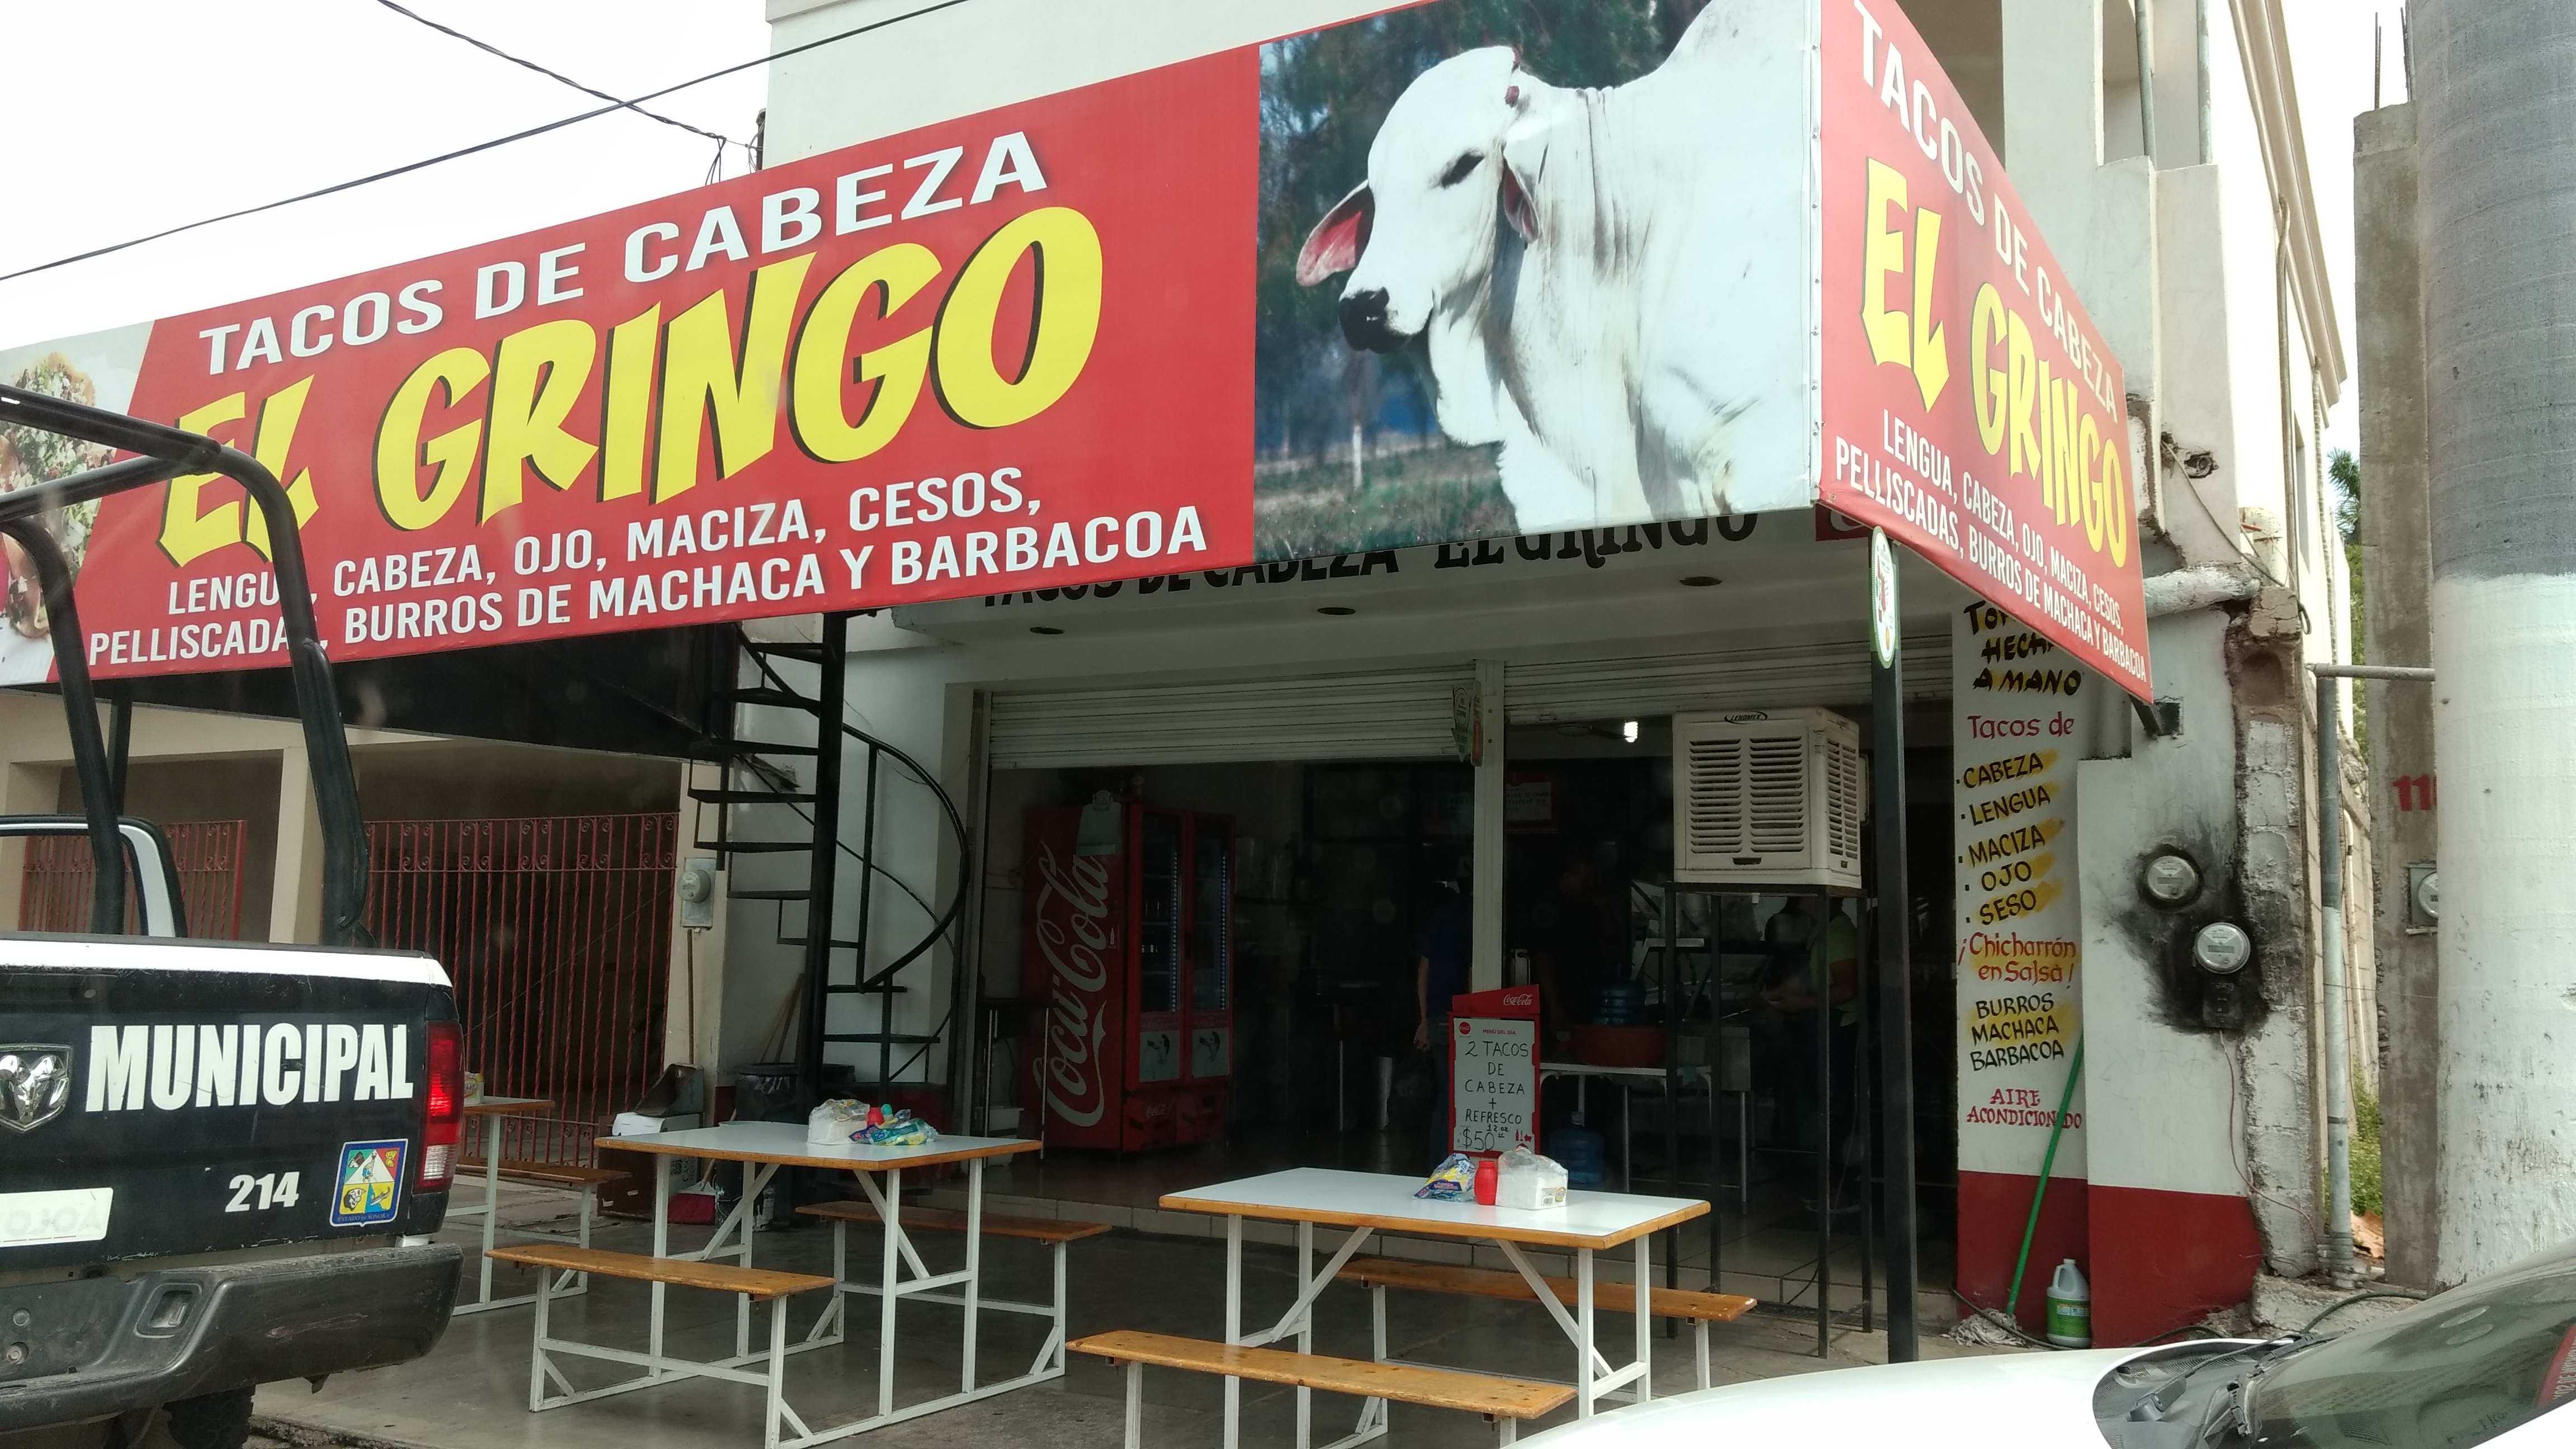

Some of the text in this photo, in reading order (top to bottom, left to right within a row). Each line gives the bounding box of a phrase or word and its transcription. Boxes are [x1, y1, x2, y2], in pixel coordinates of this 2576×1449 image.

[1853, 0, 2119, 423] TACOS DE CABEZA
[199, 131, 1048, 375] TACOS DE CABEZA
[1860, 156, 2127, 568] EL GRINGO
[157, 206, 1103, 567] EL GRINGO
[1883, 409, 2124, 636] LENGUA, CABEZA, OJO, MACIZA, CESOS,
[168, 467, 1040, 615] LENGU, CABEZA, OJO, MACIZA, CESOS,
[1835, 435, 2147, 683] PELLISCADAS, BURROS DE MACHACA Y BARBACOA
[89, 616, 328, 666] PELLISCADA,
[345, 593, 503, 644] BURROS
[518, 584, 571, 627] DE
[589, 553, 825, 619] MACHACA
[839, 545, 874, 590] Y
[892, 505, 1208, 585] BARBACOA
[1973, 667, 2082, 695] A MANO
[1967, 711, 2075, 740] Tacos de
[1963, 752, 2044, 789] CABEZA
[1968, 785, 2051, 826] LENGUA
[2393, 774, 2437, 811] 11
[1968, 825, 2046, 868] MACIZA
[1981, 861, 2032, 892] OJO
[1979, 889, 2037, 925] SESO
[1978, 964, 2002, 981] en
[1975, 992, 2054, 1020] BURROS
[1971, 1015, 2059, 1046] MACHACA
[85, 1022, 414, 1112] MUNICIPAL
[1465, 1041, 1529, 1057] 2 TACOS
[1969, 1040, 2064, 1072] BARBACOA
[1465, 1079, 1525, 1095] CABEZA
[1488, 1062, 1504, 1076] DE
[1465, 1109, 1522, 1124] REFRESCO
[1990, 1088, 2040, 1109] AIRE
[1966, 1105, 2082, 1129] ACONDICIONDO
[1462, 1127, 1495, 1150] $50
[224, 1171, 300, 1214] 214
